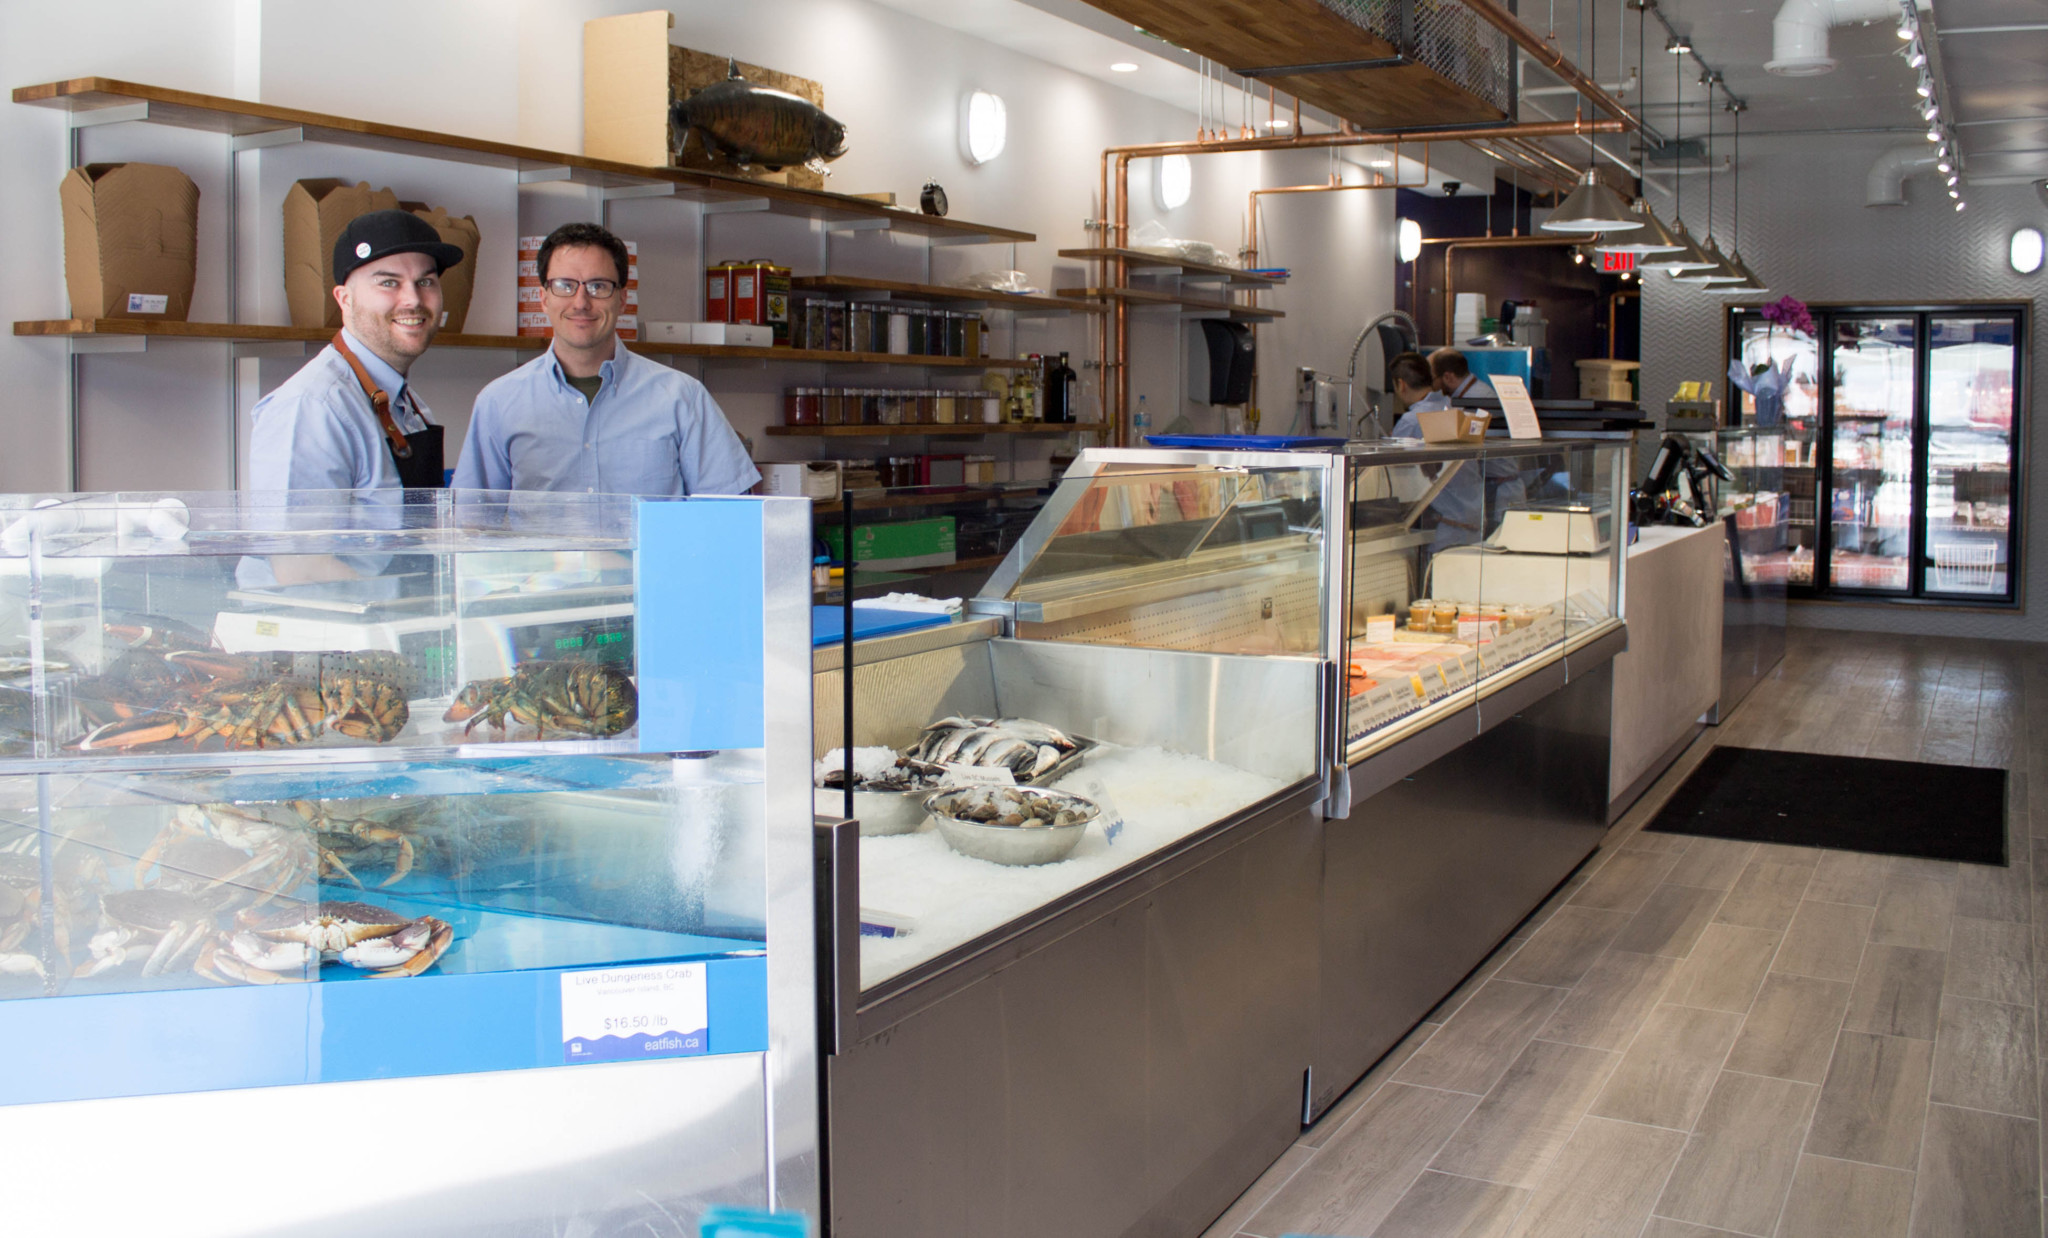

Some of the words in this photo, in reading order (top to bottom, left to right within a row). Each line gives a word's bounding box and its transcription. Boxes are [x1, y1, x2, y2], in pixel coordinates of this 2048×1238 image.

[1604, 251, 1634, 271] EXIT
[576, 975, 598, 986] Live
[601, 973, 663, 984] Dungeness
[666, 968, 692, 980] Crab
[663, 983, 675, 991] BC
[604, 1015, 649, 1031] $16.50
[652, 1014, 668, 1027] /lb
[644, 1036, 699, 1052] eatfish.ca
